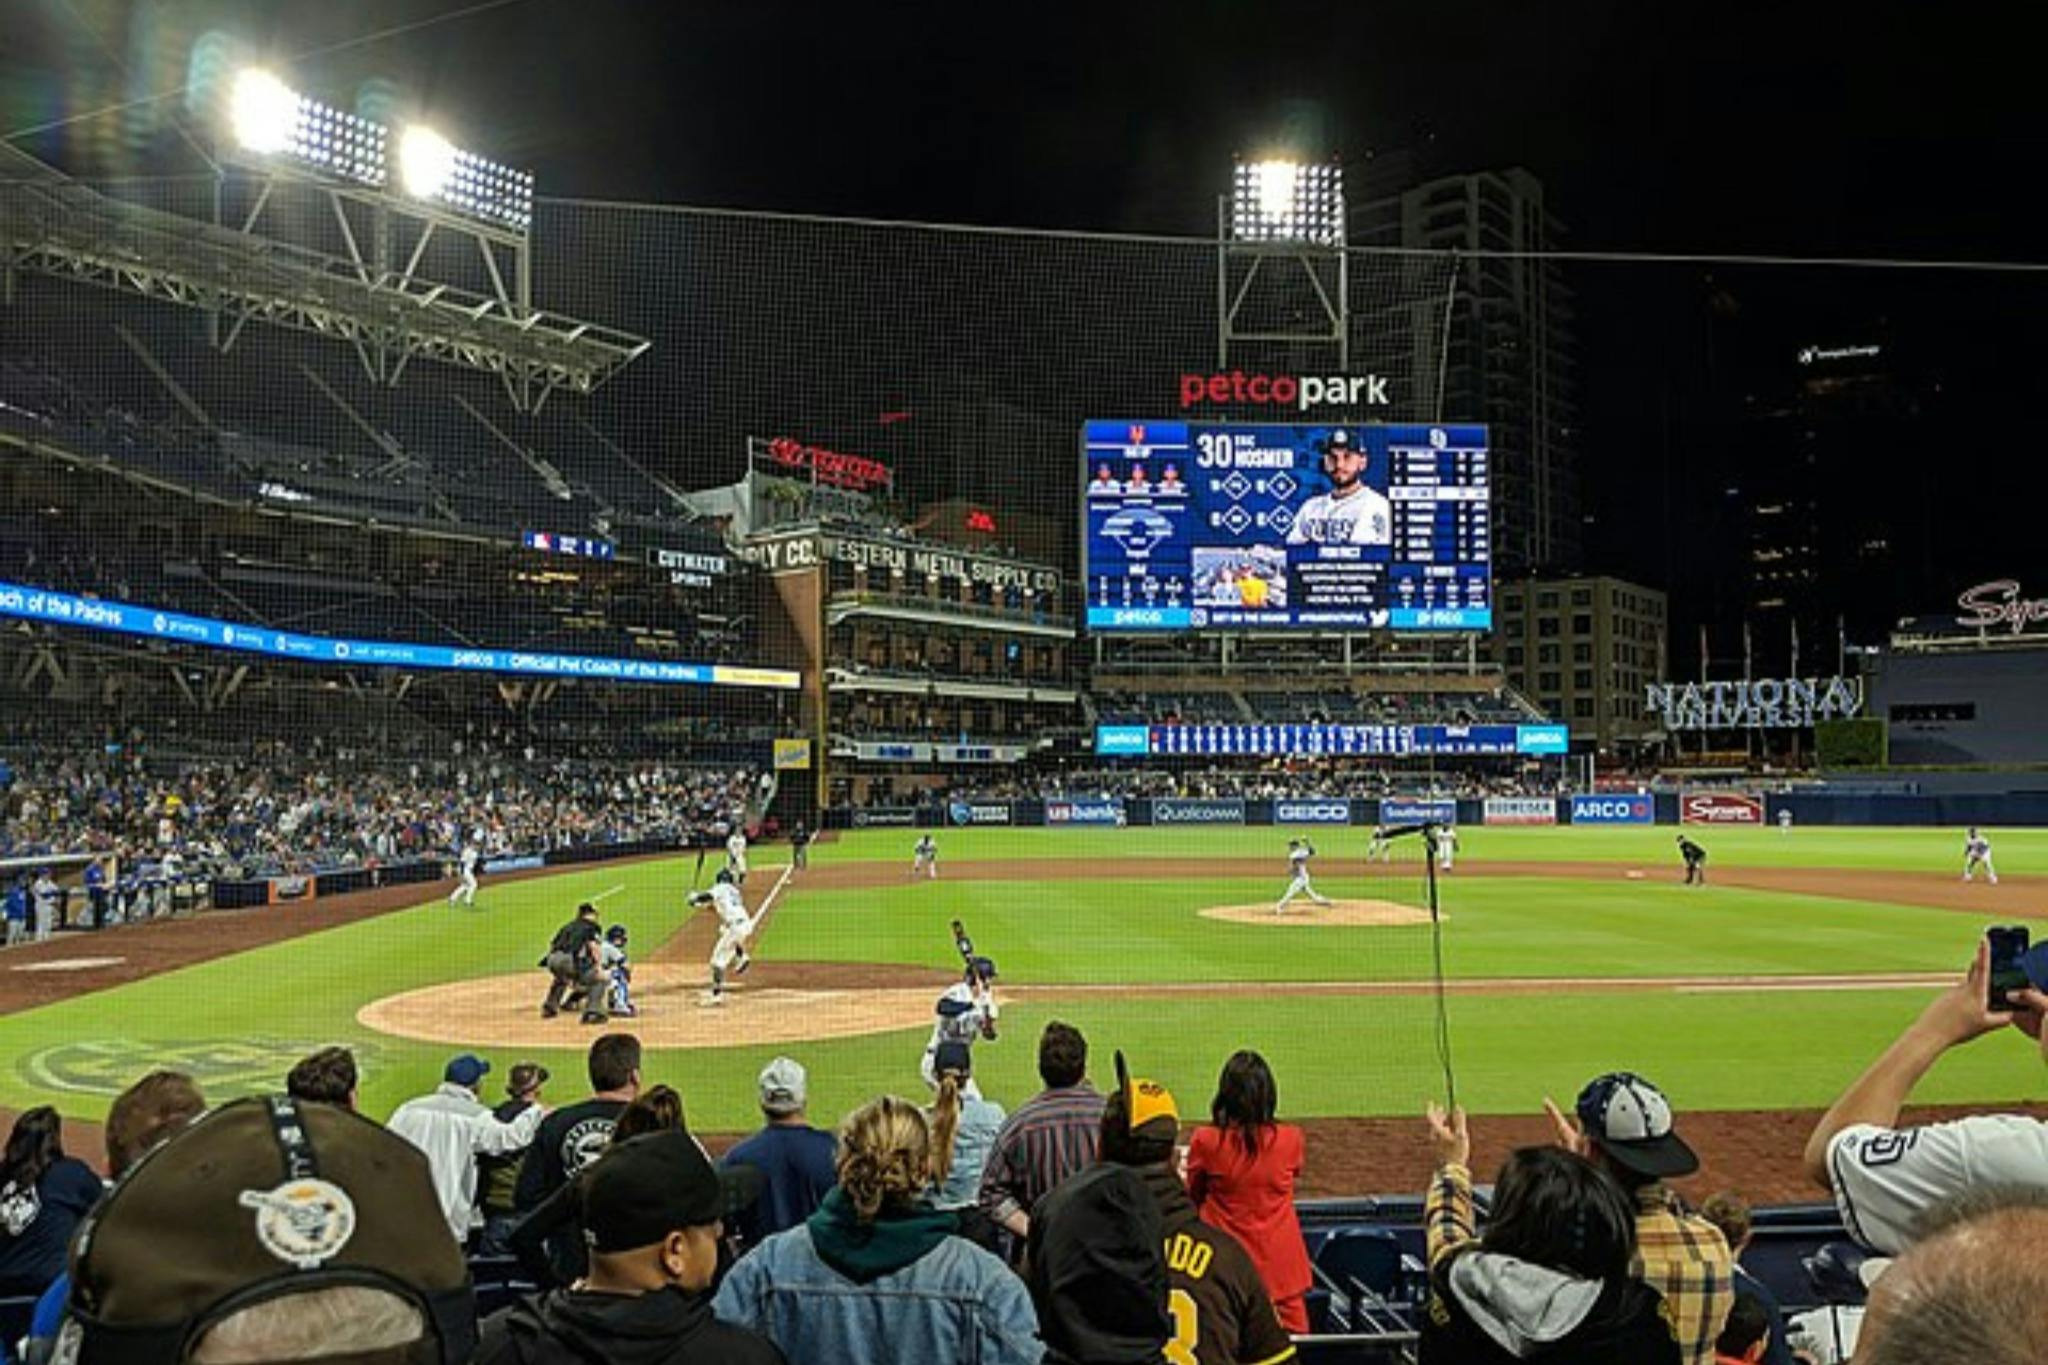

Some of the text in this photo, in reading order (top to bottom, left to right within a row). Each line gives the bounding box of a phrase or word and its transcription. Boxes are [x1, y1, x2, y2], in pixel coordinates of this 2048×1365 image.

[1197, 433, 1231, 468] 30
[1235, 448, 1293, 468] HOSMER
[47, 595, 71, 617] the
[1157, 804, 1241, 821] Qualcomm
[1278, 804, 1348, 820] GEICO
[1574, 802, 1630, 818] ARCO
[1164, 1233, 1214, 1279] DO
